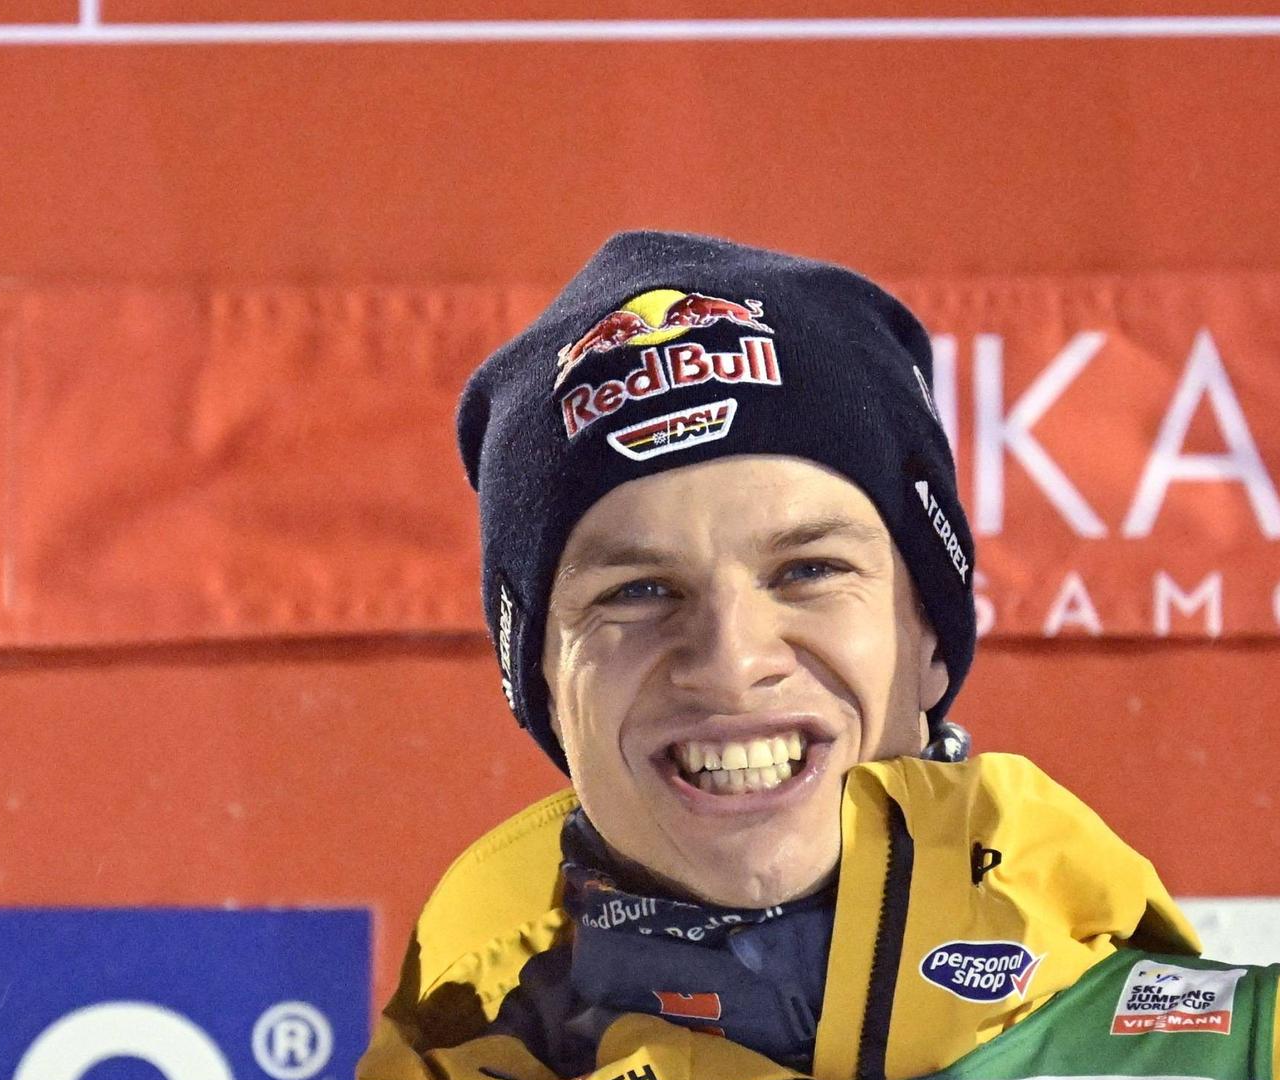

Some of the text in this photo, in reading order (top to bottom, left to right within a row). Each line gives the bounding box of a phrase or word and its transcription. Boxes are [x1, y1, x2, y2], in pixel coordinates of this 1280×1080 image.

[562, 337, 783, 440] Red Bull
[928, 494, 969, 584] TERREX
[930, 951, 1024, 973] personal
[952, 967, 1006, 992] shop
[1132, 985, 1163, 994] SKI
[1127, 998, 1210, 1011] WORLD CUP
[1128, 989, 1215, 1003] JUMPING
